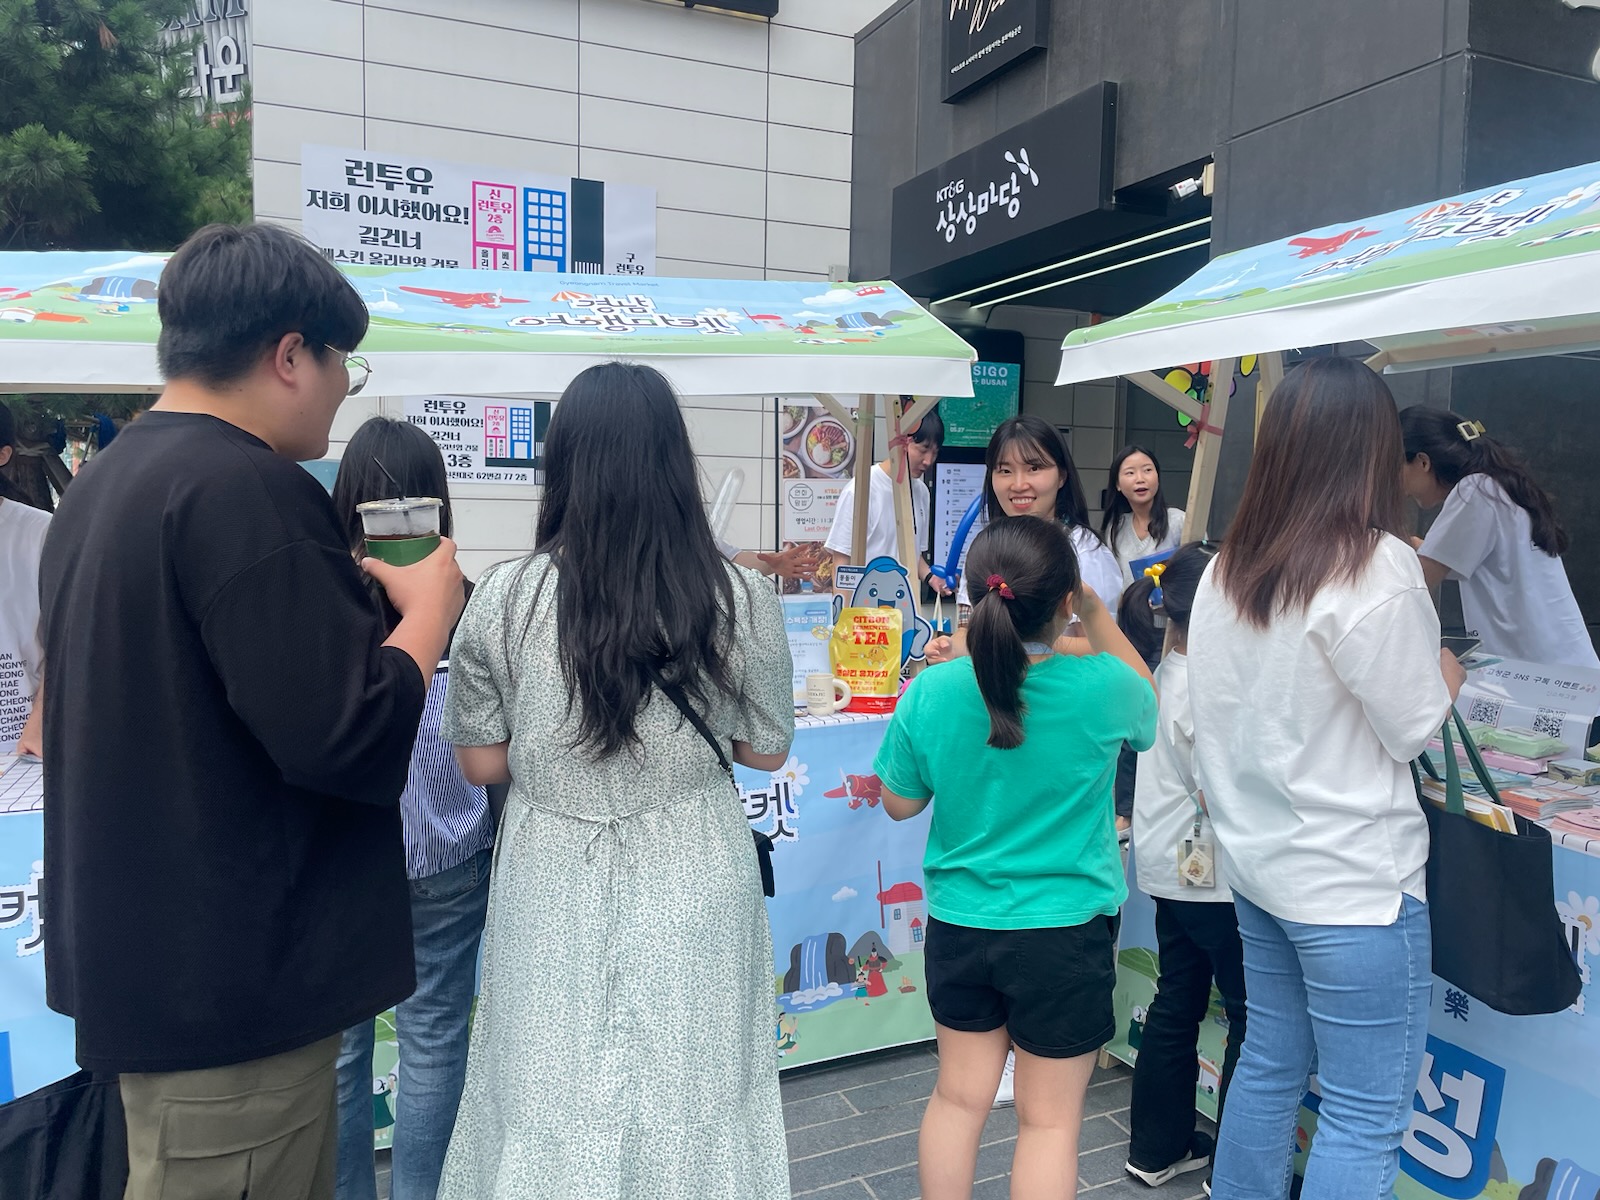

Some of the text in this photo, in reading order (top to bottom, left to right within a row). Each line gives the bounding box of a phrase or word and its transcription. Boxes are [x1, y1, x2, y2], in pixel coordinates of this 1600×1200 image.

[345, 158, 434, 195] 런투유
[489, 189, 501, 200] 신
[936, 178, 965, 204] KT&G
[306, 188, 469, 225] 저희 이사했어요!
[478, 199, 512, 214] 런투유
[935, 171, 1021, 243] 상상마당
[487, 213, 503, 224] 2층
[358, 225, 422, 250] 길건너
[616, 262, 645, 275] 런투유
[576, 297, 649, 314] 경남
[515, 314, 742, 336] 여행마켓
[980, 378, 1008, 386] BUSAN
[424, 400, 466, 414] 런투유
[429, 416, 484, 428] 이사했어요!
[430, 430, 460, 441] 길건너
[447, 454, 472, 468] 3층
[504, 473, 513, 481] 77
[853, 615, 890, 624] CITRON
[852, 631, 889, 645] TEA
[1, 680, 19, 688] HAE
[1513, 672, 1530, 681] SNS
[1554, 679, 1579, 691] 이벤트
